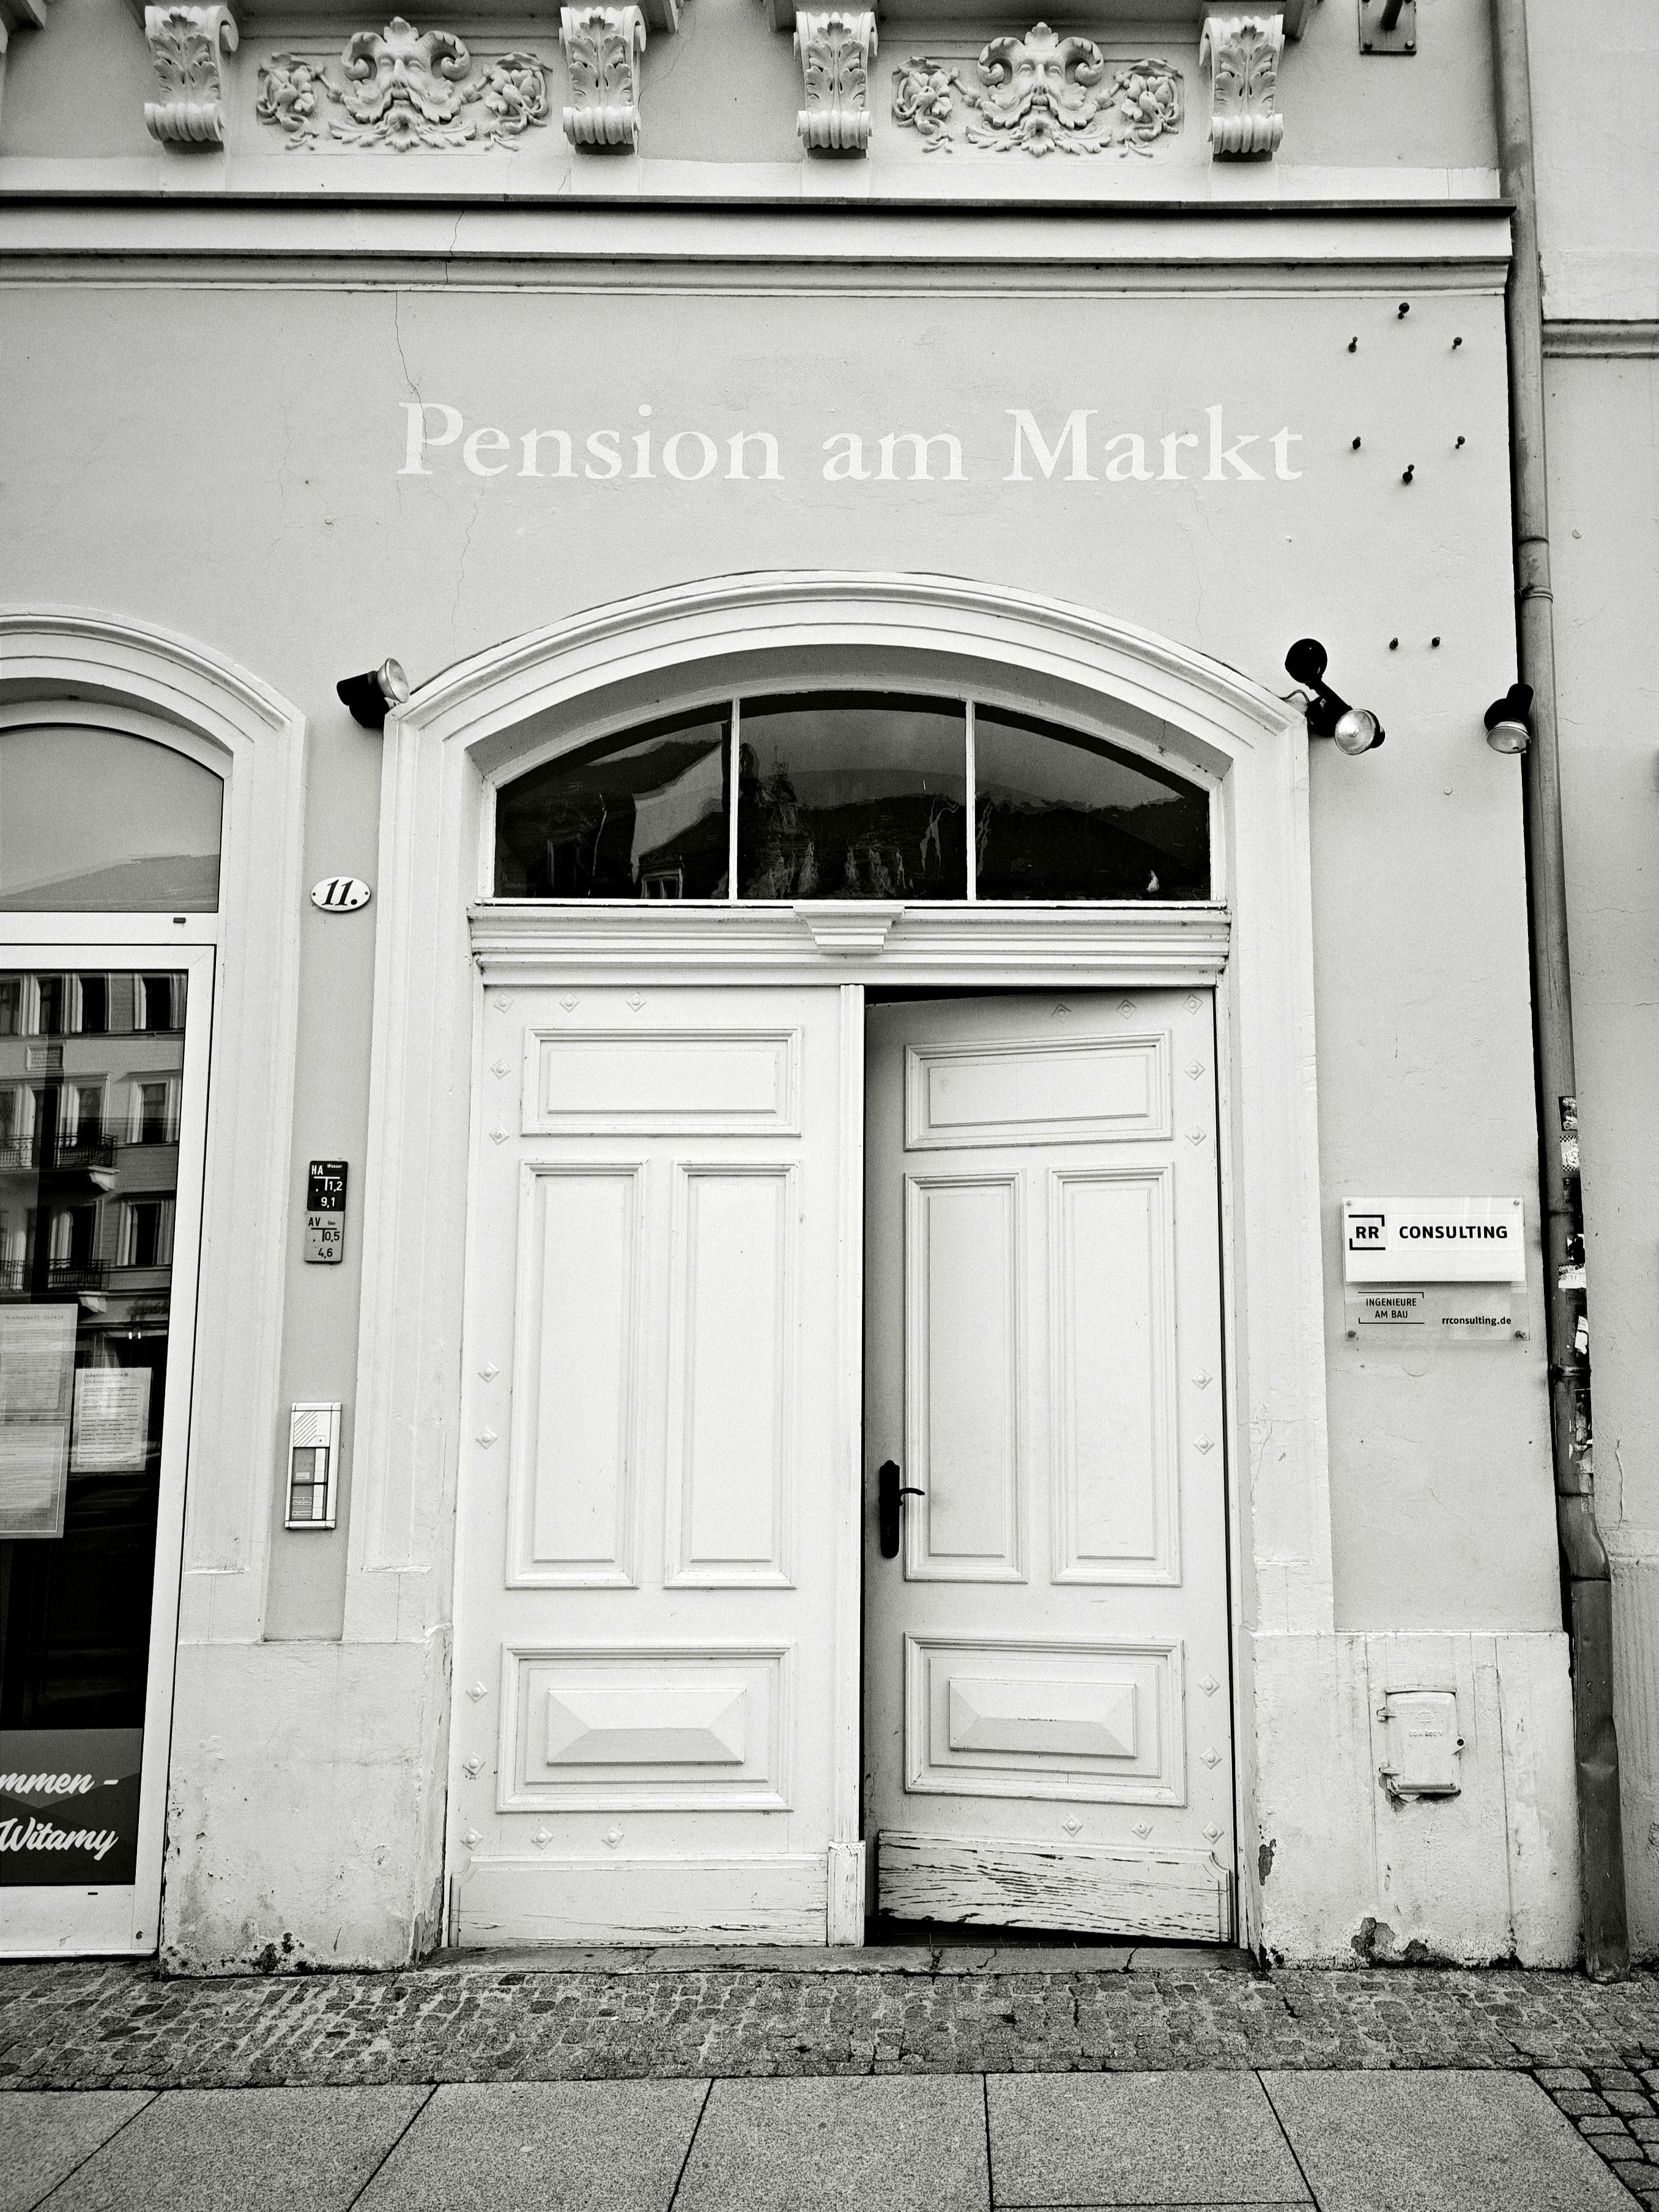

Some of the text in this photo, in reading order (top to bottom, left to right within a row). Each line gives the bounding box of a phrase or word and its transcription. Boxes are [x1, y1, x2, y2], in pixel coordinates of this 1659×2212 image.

[396, 401, 1304, 483] Pension am Markt
[321, 879, 358, 906] 11.
[311, 1165, 324, 1175] HA
[321, 1196, 335, 1208] 9,1
[308, 1217, 321, 1227] AV
[1356, 1226, 1508, 1239] RR CONSULTING
[317, 1248, 333, 1259] 4,6
[1366, 1298, 1417, 1307] INGENIEURE
[1375, 1310, 1408, 1319] AM BAU
[1442, 1316, 1512, 1326] rrconsulting.de
[0, 1817, 119, 1861] Witamy
